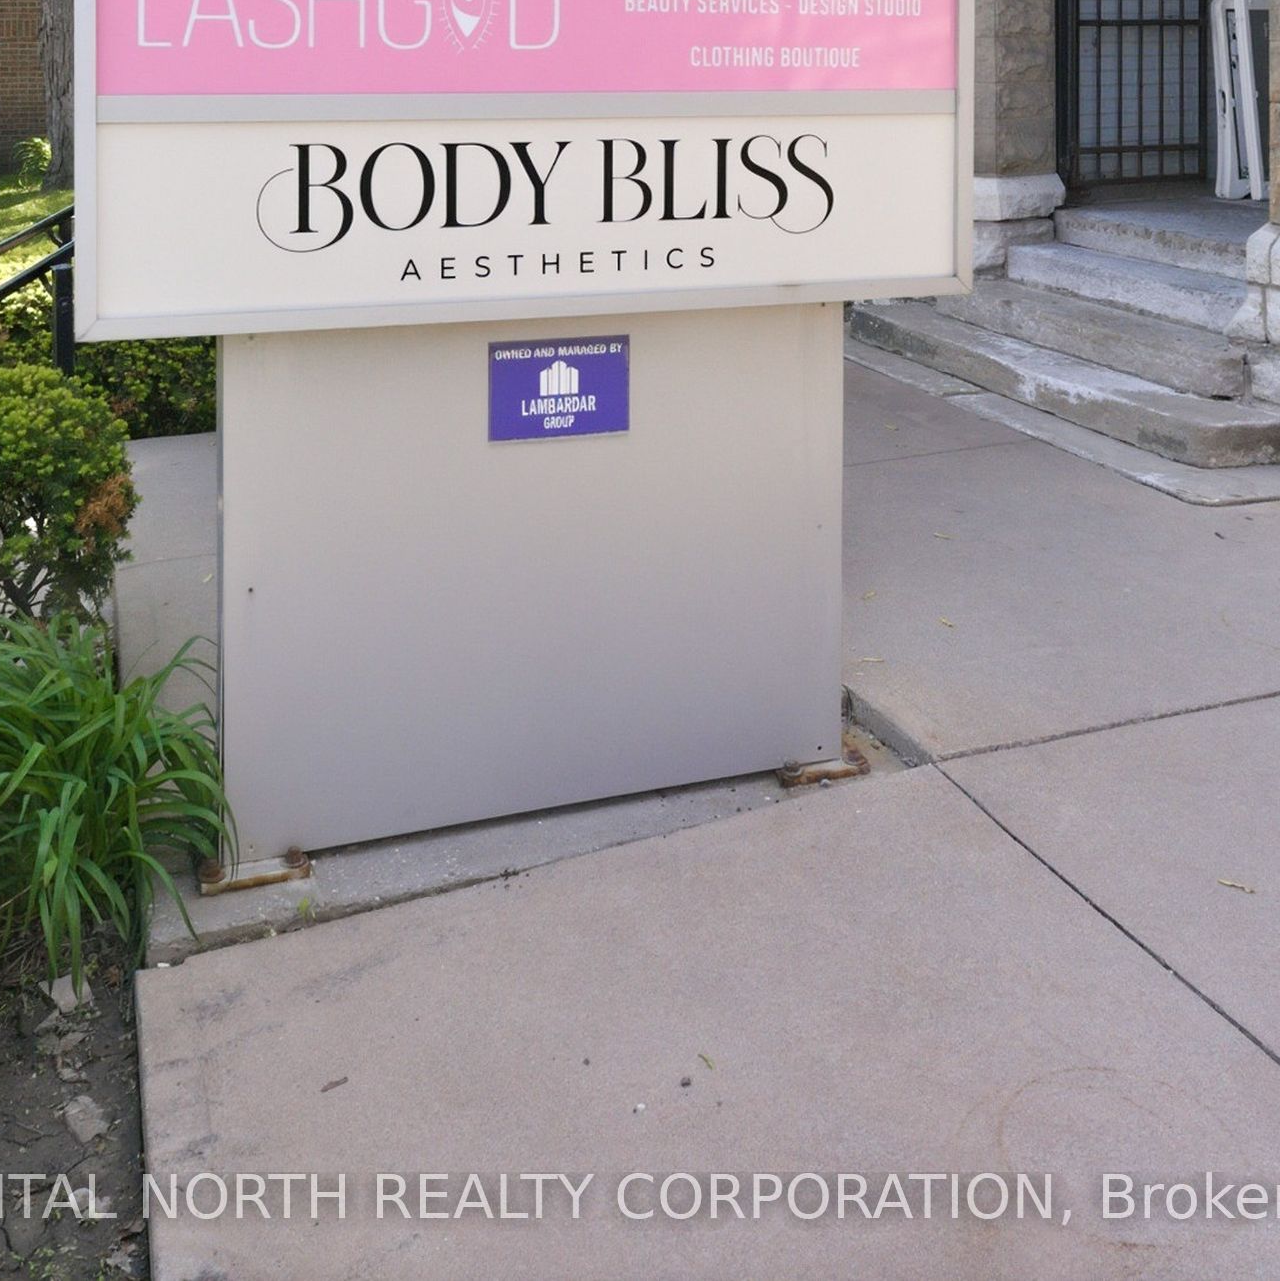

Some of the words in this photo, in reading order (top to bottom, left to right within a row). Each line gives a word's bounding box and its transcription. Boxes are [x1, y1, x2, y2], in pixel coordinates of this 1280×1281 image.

[690, 46, 774, 67] CLOTHING
[780, 46, 861, 68] BOUTIQUE
[256, 141, 573, 253] BODY
[596, 133, 834, 234] BLISS
[401, 246, 716, 281] AESTHETICS
[495, 349, 532, 361] OWNED
[534, 347, 556, 358] AND
[558, 344, 607, 357] MANAGED
[609, 343, 623, 353] BY
[521, 395, 597, 416] LAMBARDAR
[543, 415, 575, 429] GROUP
